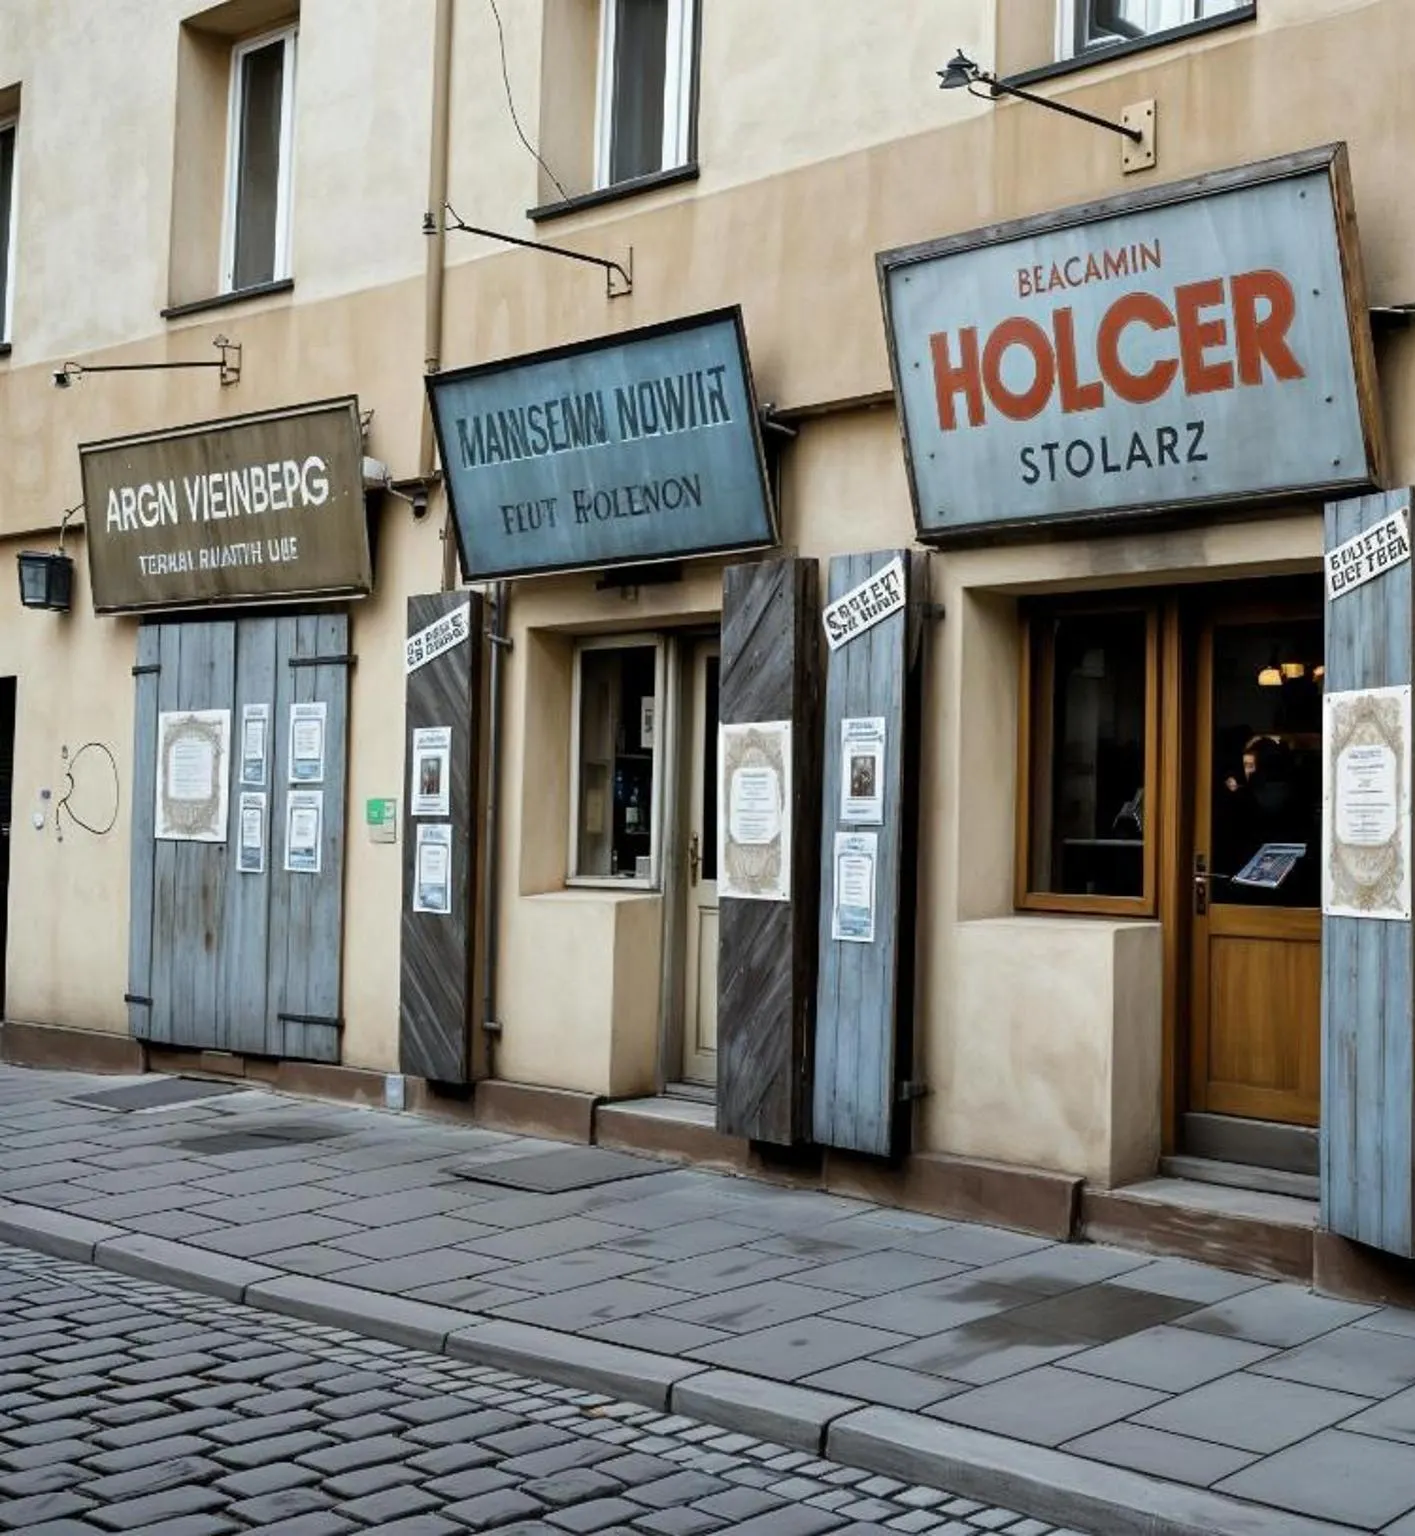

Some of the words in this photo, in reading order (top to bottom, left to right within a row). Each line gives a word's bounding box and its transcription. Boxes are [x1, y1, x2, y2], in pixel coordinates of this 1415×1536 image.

[1017, 238, 1162, 298] BEACAMIN
[929, 268, 1306, 432] HOLCER
[1021, 421, 1209, 485] STOLARZ
[106, 479, 179, 533] ARGN
